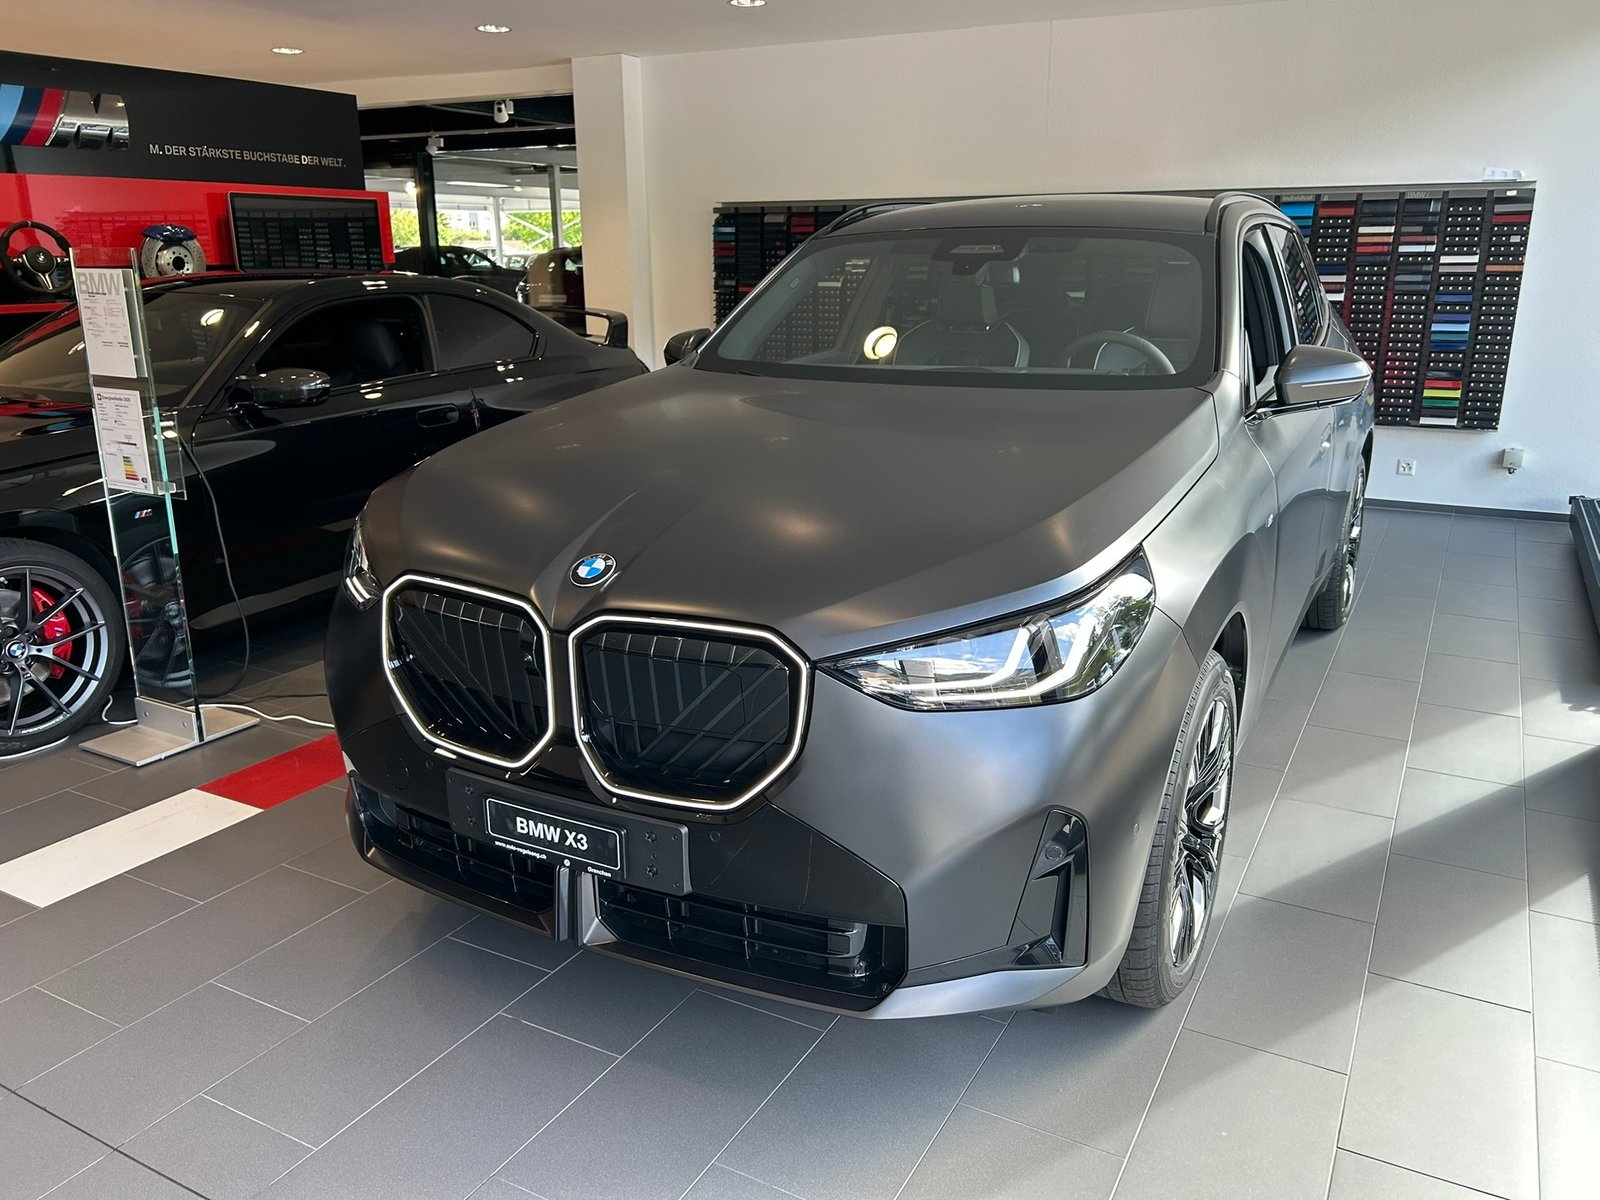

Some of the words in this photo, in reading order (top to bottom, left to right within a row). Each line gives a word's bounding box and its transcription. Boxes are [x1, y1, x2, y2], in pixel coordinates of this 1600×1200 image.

[149, 144, 163, 155] M.
[164, 144, 187, 157] DER
[188, 145, 242, 160] STÄRKSTE
[243, 150, 300, 164] BUCHSTABE
[301, 155, 320, 166] DER
[320, 157, 347, 168] WELT.
[78, 272, 121, 296] BMW
[516, 816, 561, 843] BMW
[564, 829, 588, 851] X3
[587, 866, 612, 878] Grenchen
